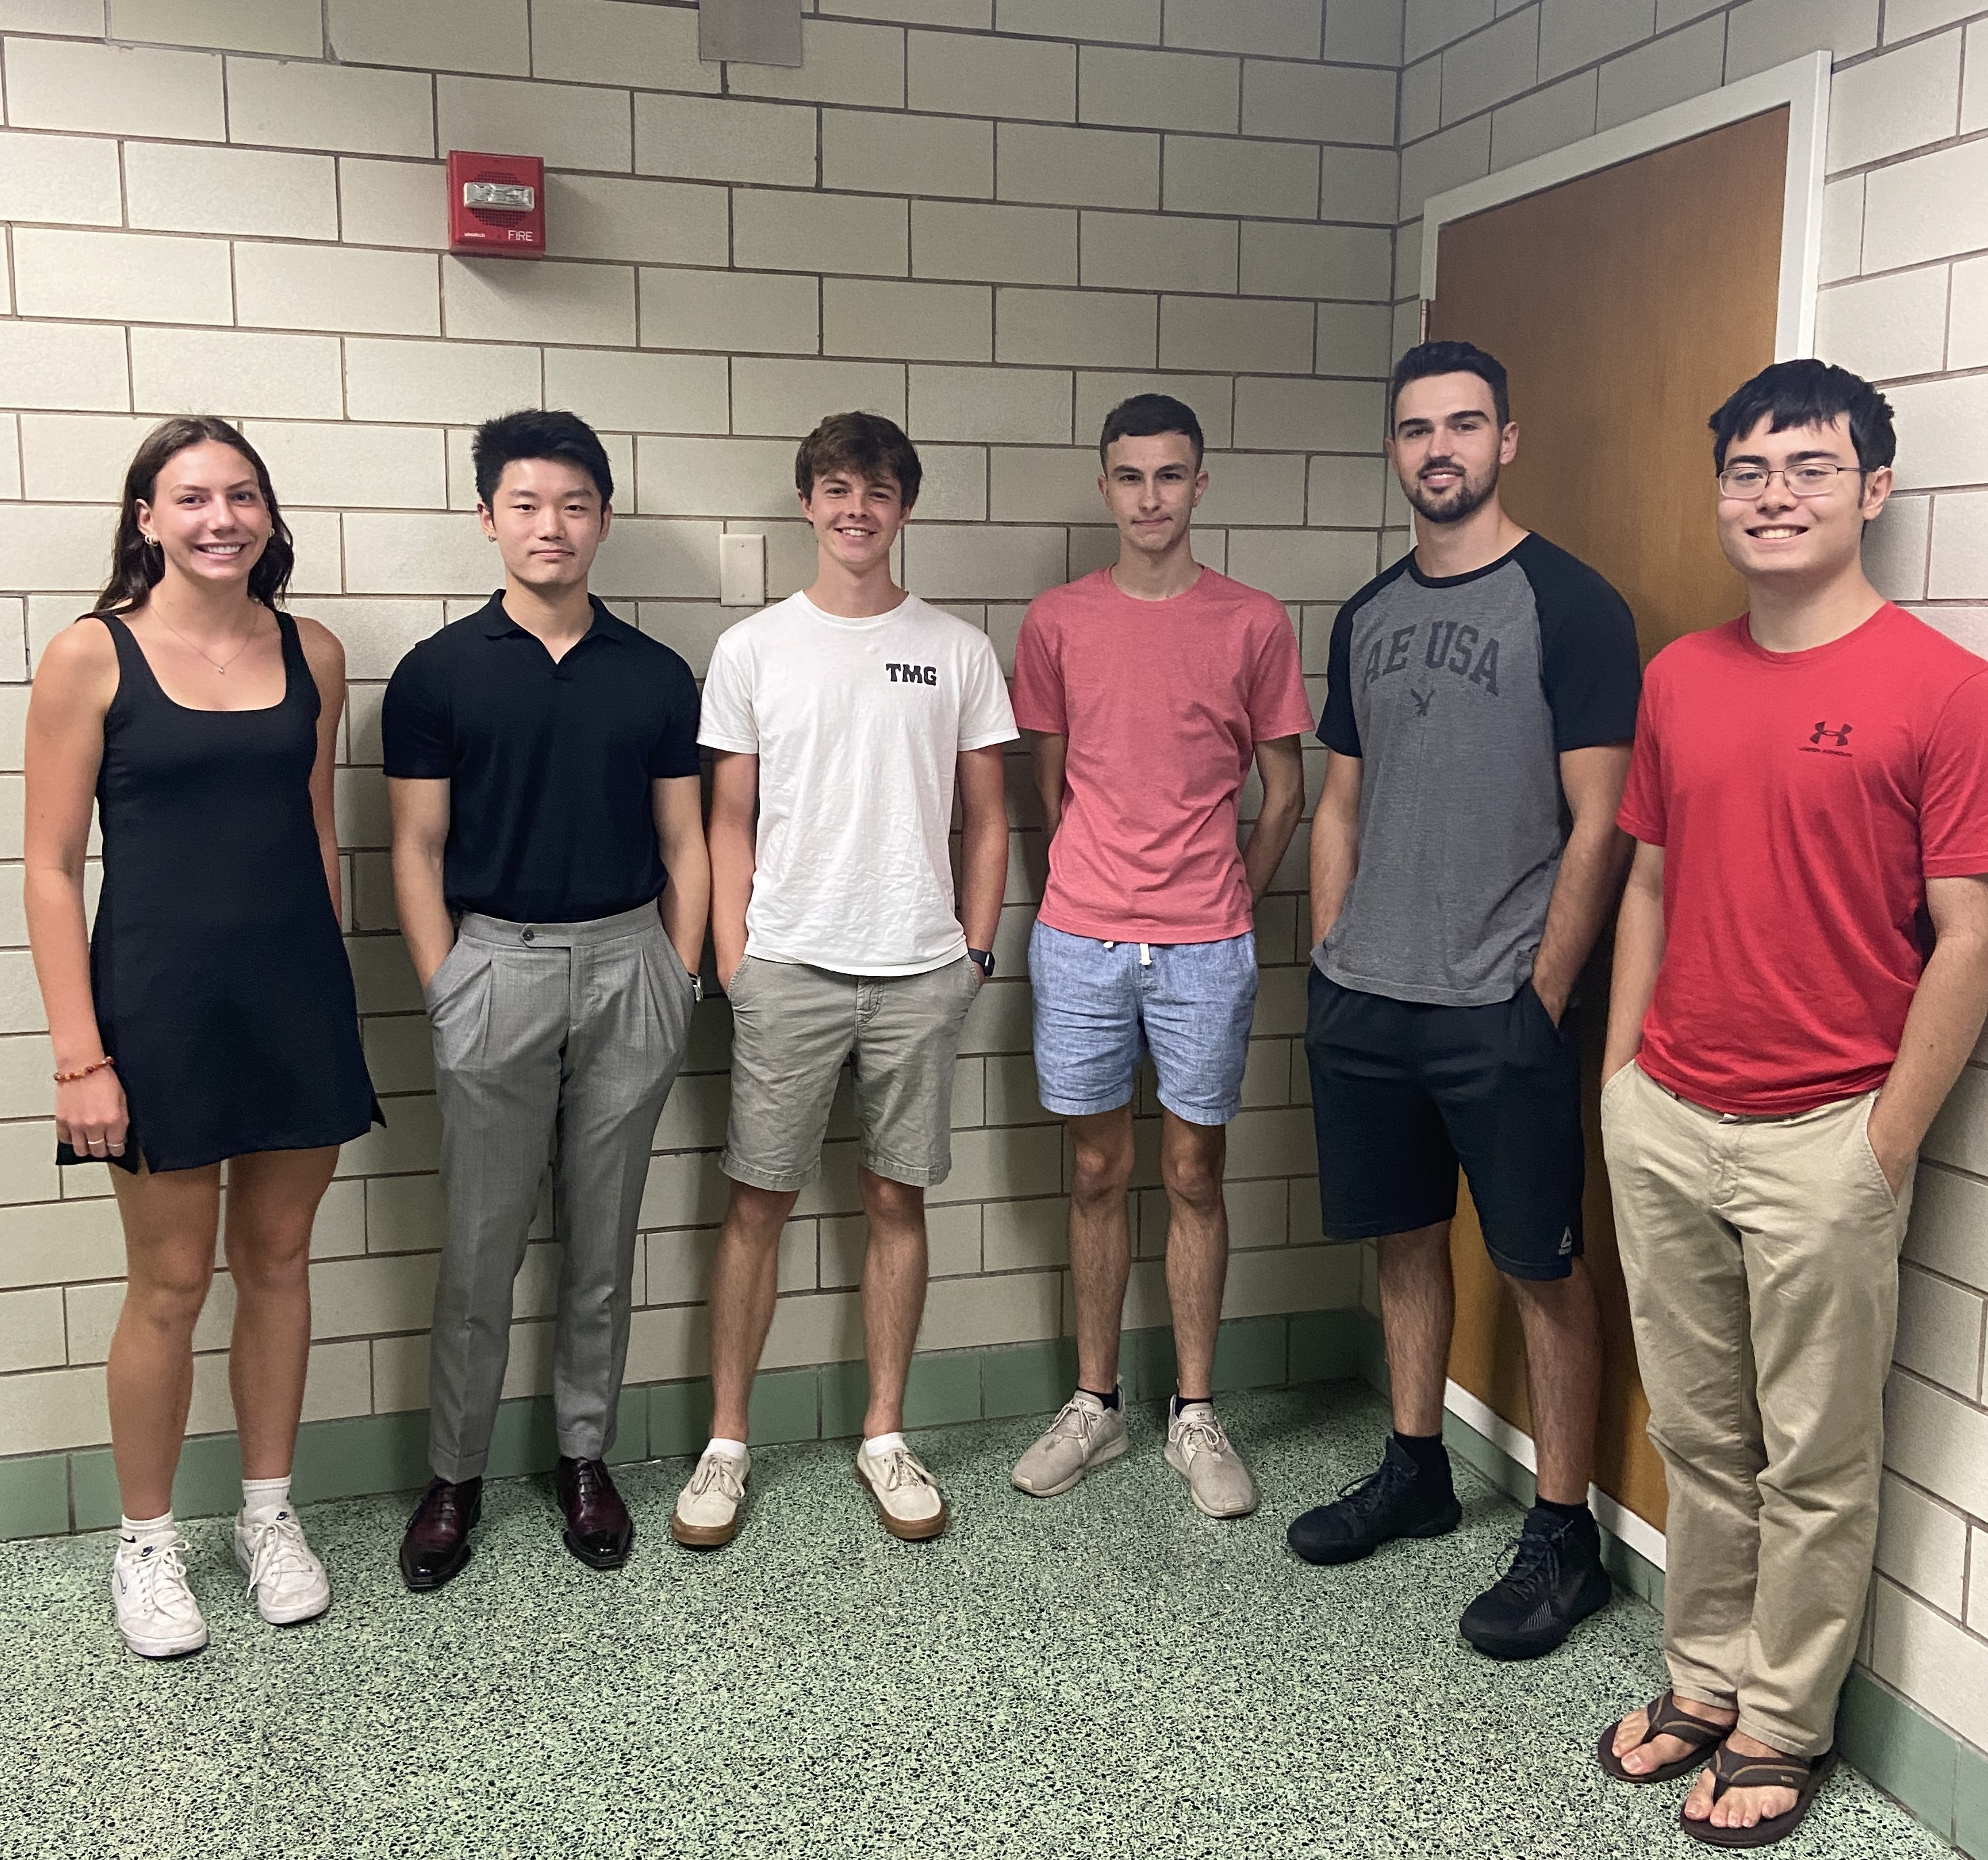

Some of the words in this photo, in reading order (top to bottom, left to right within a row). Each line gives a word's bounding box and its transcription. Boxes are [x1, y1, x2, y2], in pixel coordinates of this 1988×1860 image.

[508, 230, 534, 242] FIRE
[1425, 620, 1499, 697] USA
[885, 663, 937, 687] TMG
